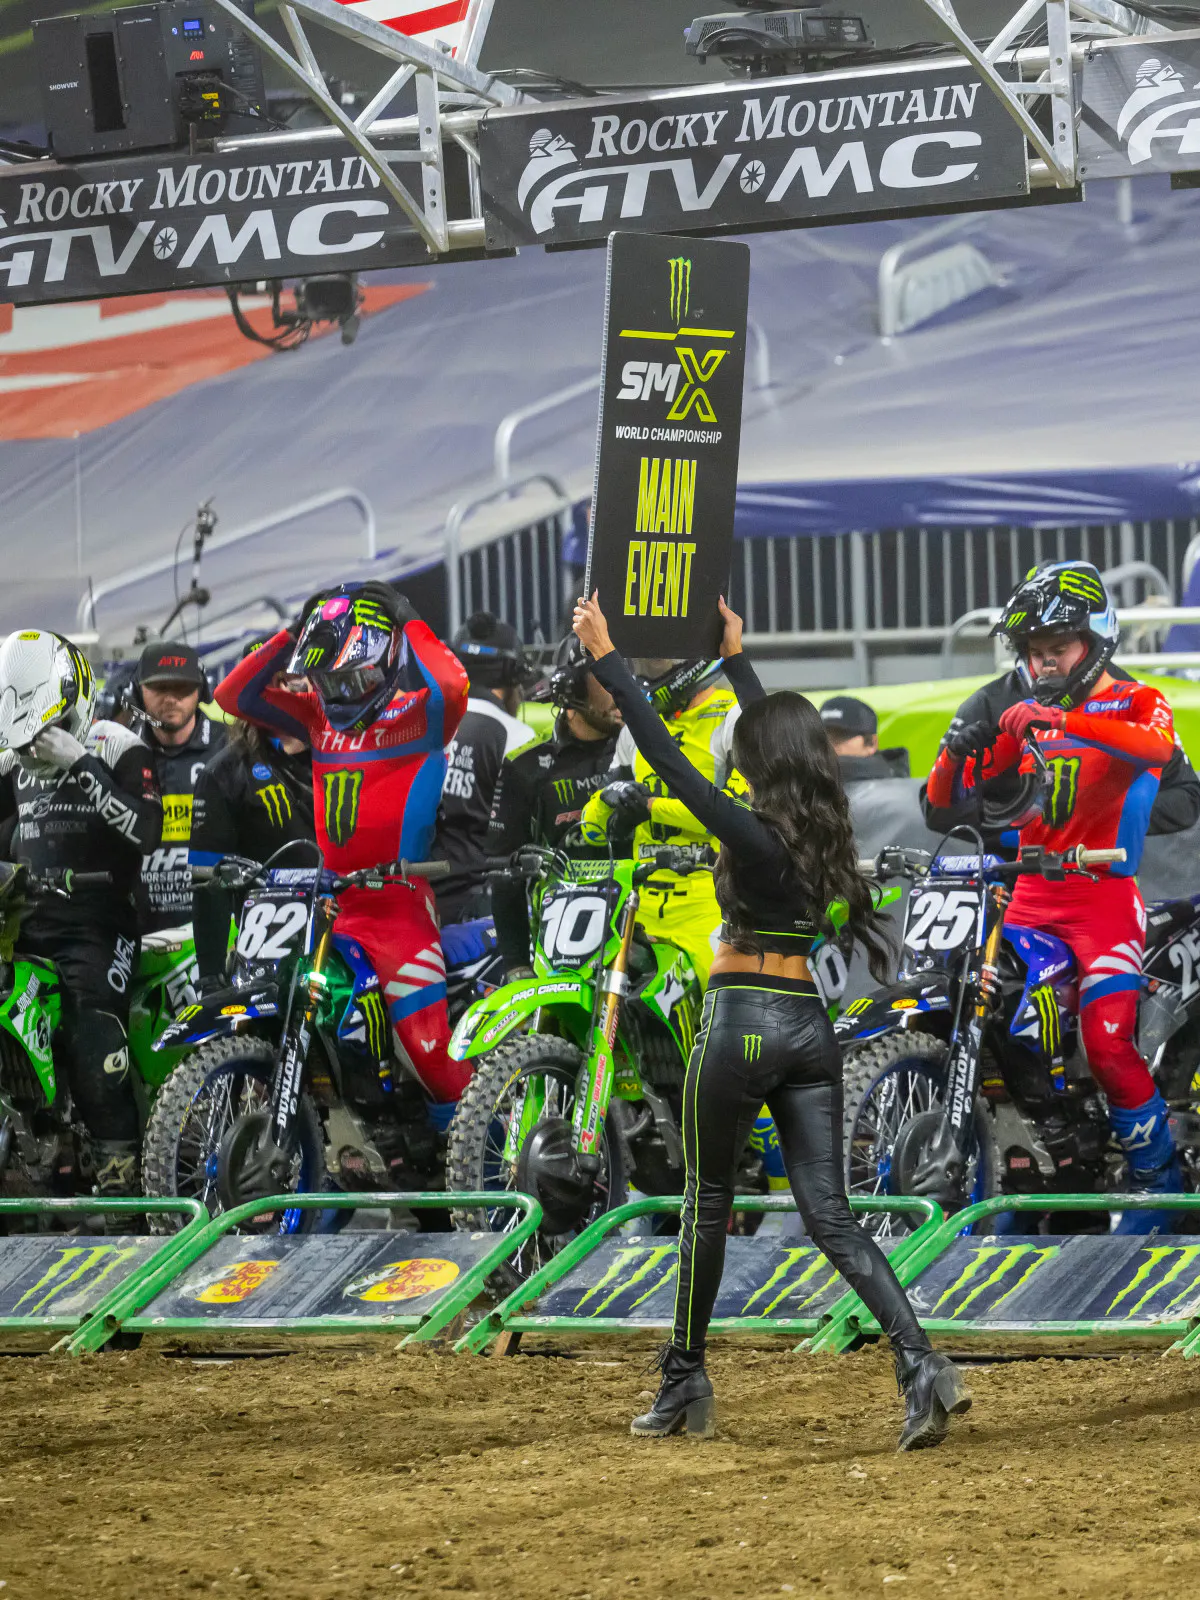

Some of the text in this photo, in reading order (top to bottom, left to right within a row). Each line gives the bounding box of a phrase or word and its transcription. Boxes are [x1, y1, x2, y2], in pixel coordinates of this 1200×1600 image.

[585, 82, 982, 160] ROCKY MOUNTAIN
[14, 155, 382, 225] ROCKY MOUNTAIN
[616, 346, 727, 423] SMX
[615, 425, 723, 444] WORLD CHAMPIONSHIP
[635, 456, 697, 535] MAIN
[623, 540, 697, 618] EVENT
[237, 901, 308, 960] 82
[541, 895, 607, 959] 10
[904, 890, 980, 951] 25
[277, 1047, 298, 1129] DUNLOP
[951, 1044, 970, 1129] DUNLOP
